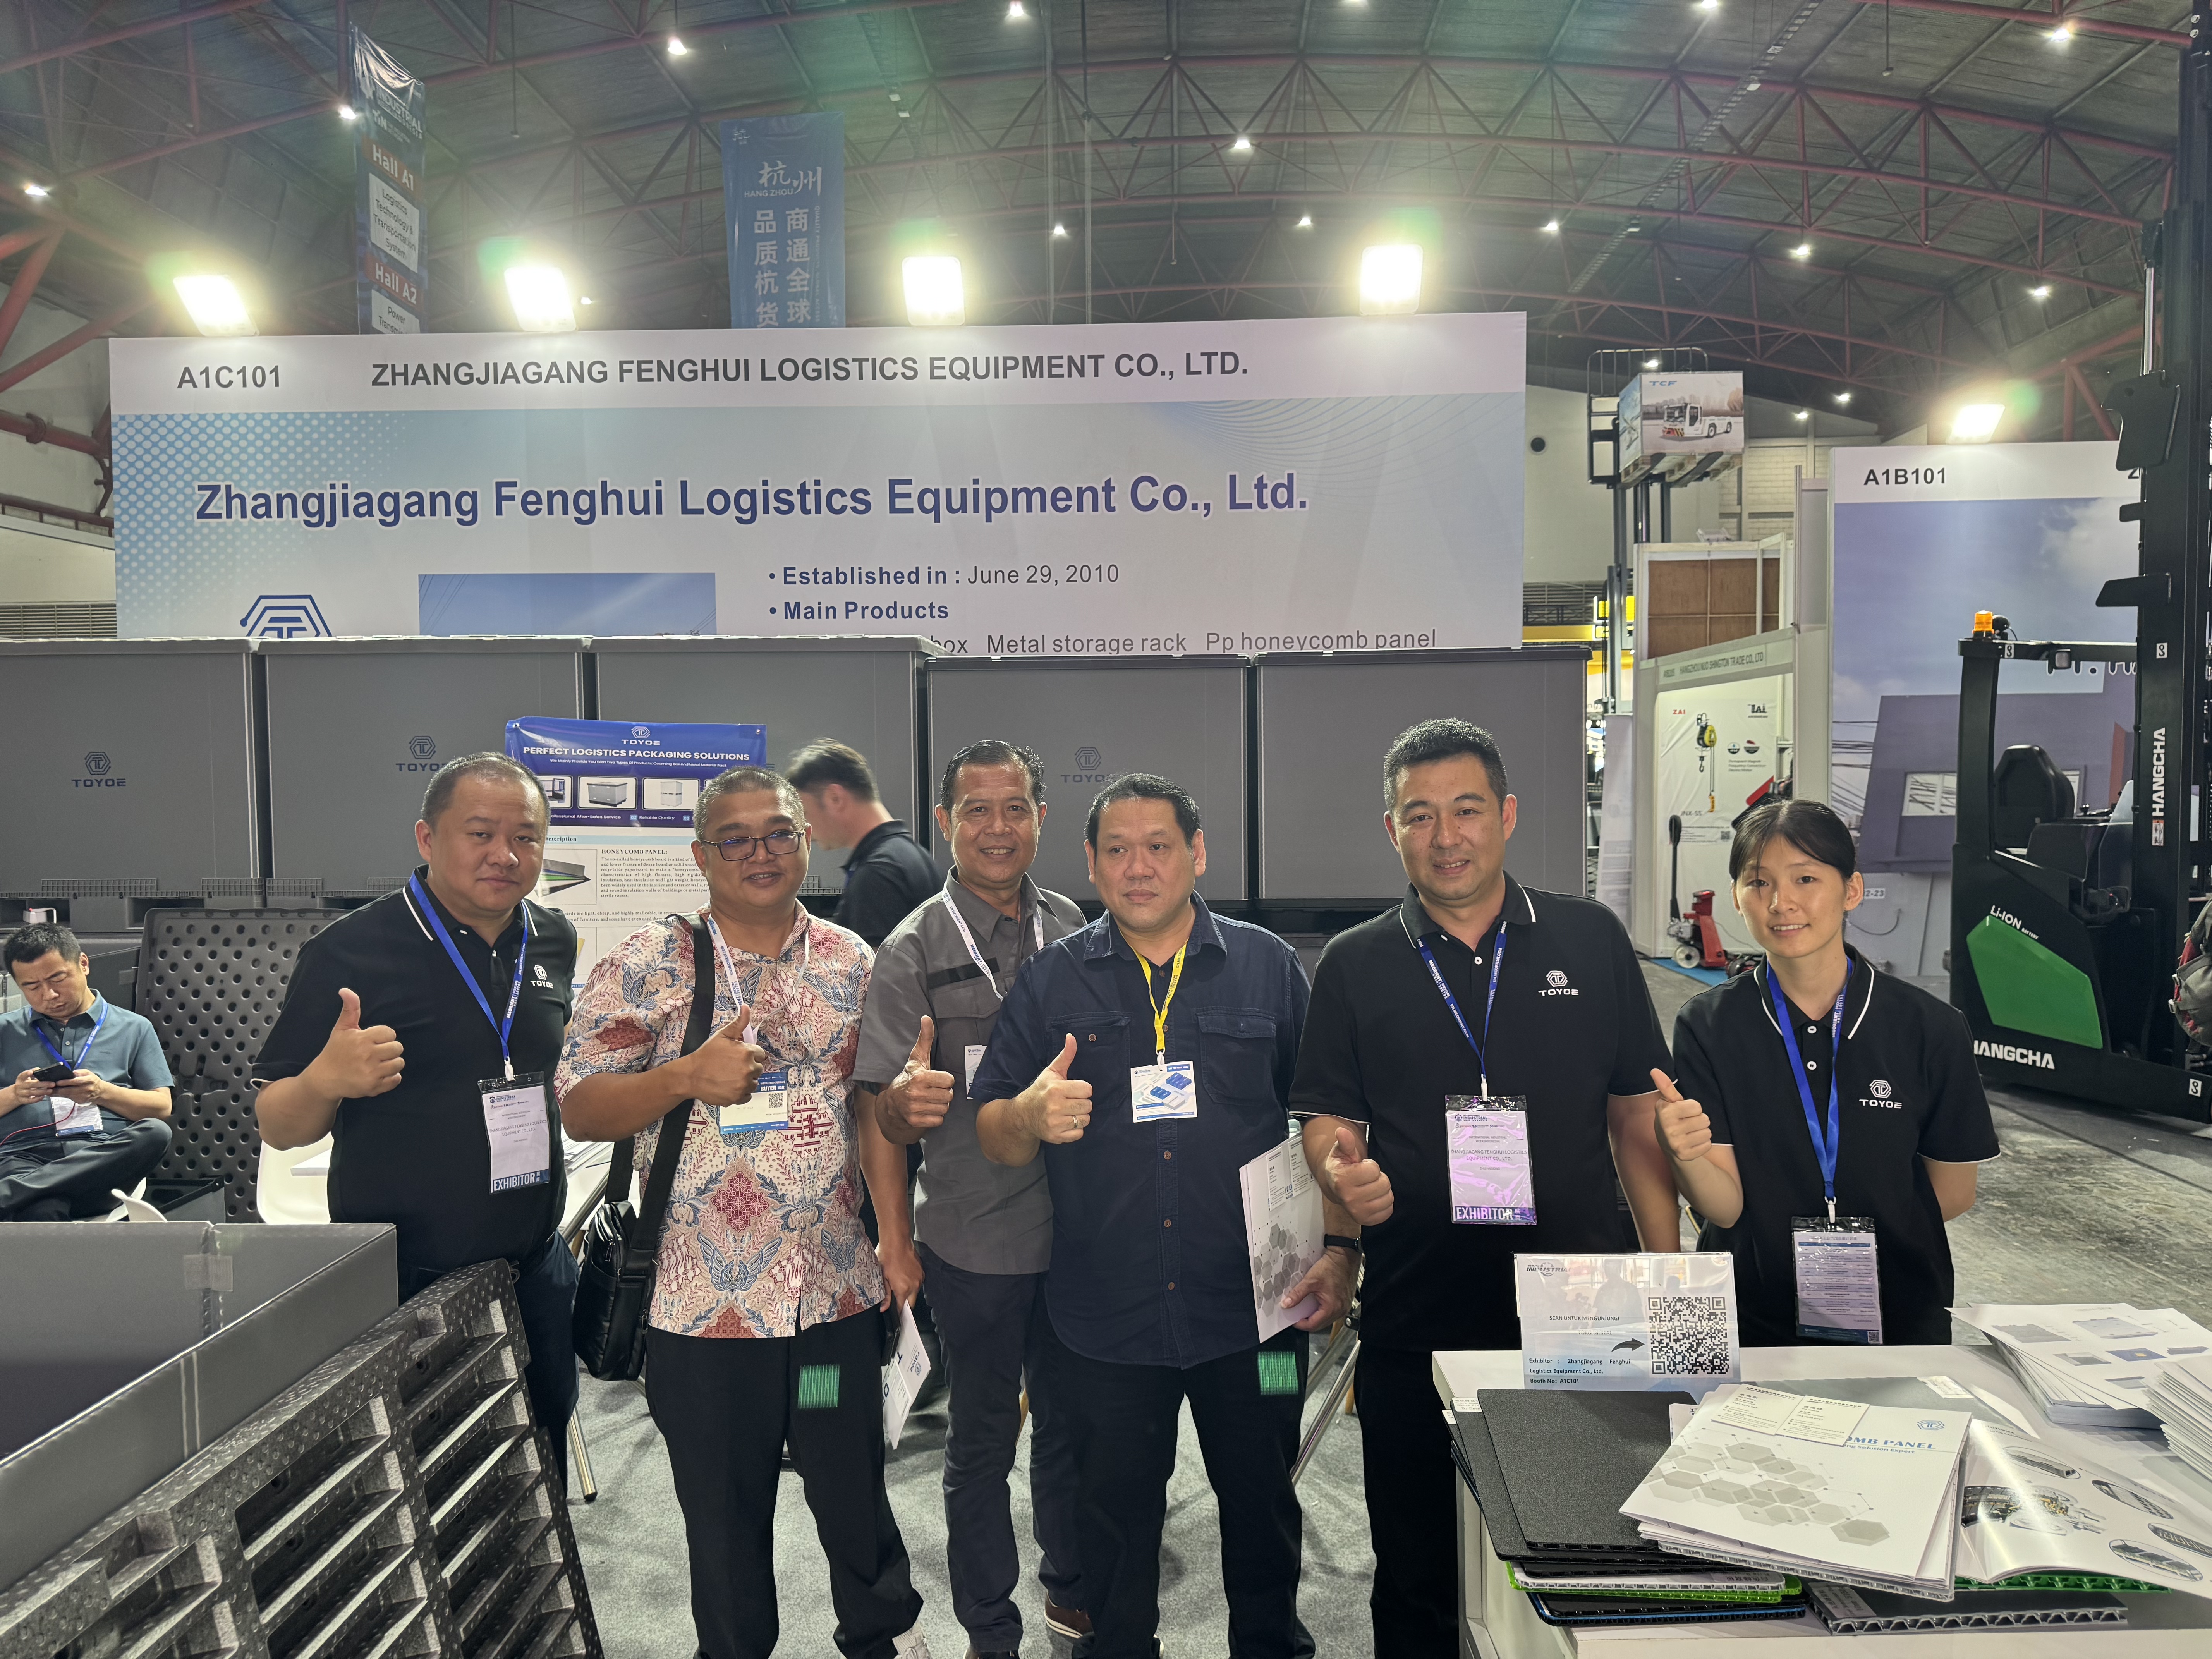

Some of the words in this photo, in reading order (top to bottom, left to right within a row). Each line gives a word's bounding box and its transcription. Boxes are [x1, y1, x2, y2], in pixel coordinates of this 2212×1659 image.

[373, 144, 398, 178] Hall
[402, 170, 413, 190] A1
[759, 160, 822, 196] 杭州
[382, 189, 407, 215] Logistics
[376, 199, 409, 232] Technology
[373, 214, 416, 251] Transportation
[386, 238, 406, 260] System
[754, 210, 778, 328] 品质杭货
[786, 208, 811, 323] 商通全球
[376, 263, 398, 293] Hall
[403, 283, 416, 304] A2
[388, 306, 405, 324] Power
[177, 366, 279, 388] A1C101
[372, 361, 607, 386] ZHANGJIAGANG
[619, 359, 749, 382] FENGHUI
[761, 357, 918, 381] LOGISTICS
[930, 354, 1105, 381] EQUIPMENT
[1115, 354, 1173, 380] CO.,
[1186, 352, 1247, 375] LTD.
[1864, 468, 1944, 485] A1B101
[197, 483, 477, 527] Zhangjiagang
[495, 480, 662, 525] Fenghui
[680, 479, 871, 524] Logistics
[889, 478, 1116, 523] Equipment
[1131, 476, 1210, 517] Co.,
[1230, 473, 1306, 509] Ltd.
[784, 567, 919, 584] Established
[928, 566, 946, 584] in
[968, 566, 1018, 584] June
[1027, 565, 1058, 586] 29,
[1066, 564, 1118, 582] 2010
[785, 602, 836, 619] Main
[845, 601, 948, 619] Products
[988, 635, 1044, 653] Metal
[1052, 635, 1136, 654] storage
[1140, 633, 1187, 653] rack
[1206, 632, 1235, 653] Pp
[1241, 630, 1367, 651] honeycomb
[1374, 629, 1436, 649] panel
[572, 749, 626, 757] LOGISTICS
[629, 750, 692, 759] PACKAGING
[694, 752, 749, 761] SOLUTIONS
[72, 778, 126, 787] TOYOE
[1061, 775, 1105, 783] TOYO
[2152, 727, 2165, 816] HANGCHA
[1990, 905, 2022, 929] Li-ION
[2021, 927, 2039, 939] BATTERY
[1428, 959, 1442, 982] MEORIENT
[531, 981, 553, 989] TOYOE
[1438, 984, 1448, 1000] 300795
[1538, 988, 1579, 996] TOYOE
[507, 996, 515, 1018] MEORIENT
[1859, 1099, 1902, 1109] TOYOE
[493, 1172, 535, 1192] EXHIBITOR
[1457, 1207, 1513, 1220] EXHIBITOR
[1884, 1440, 1936, 1449] PANEL
